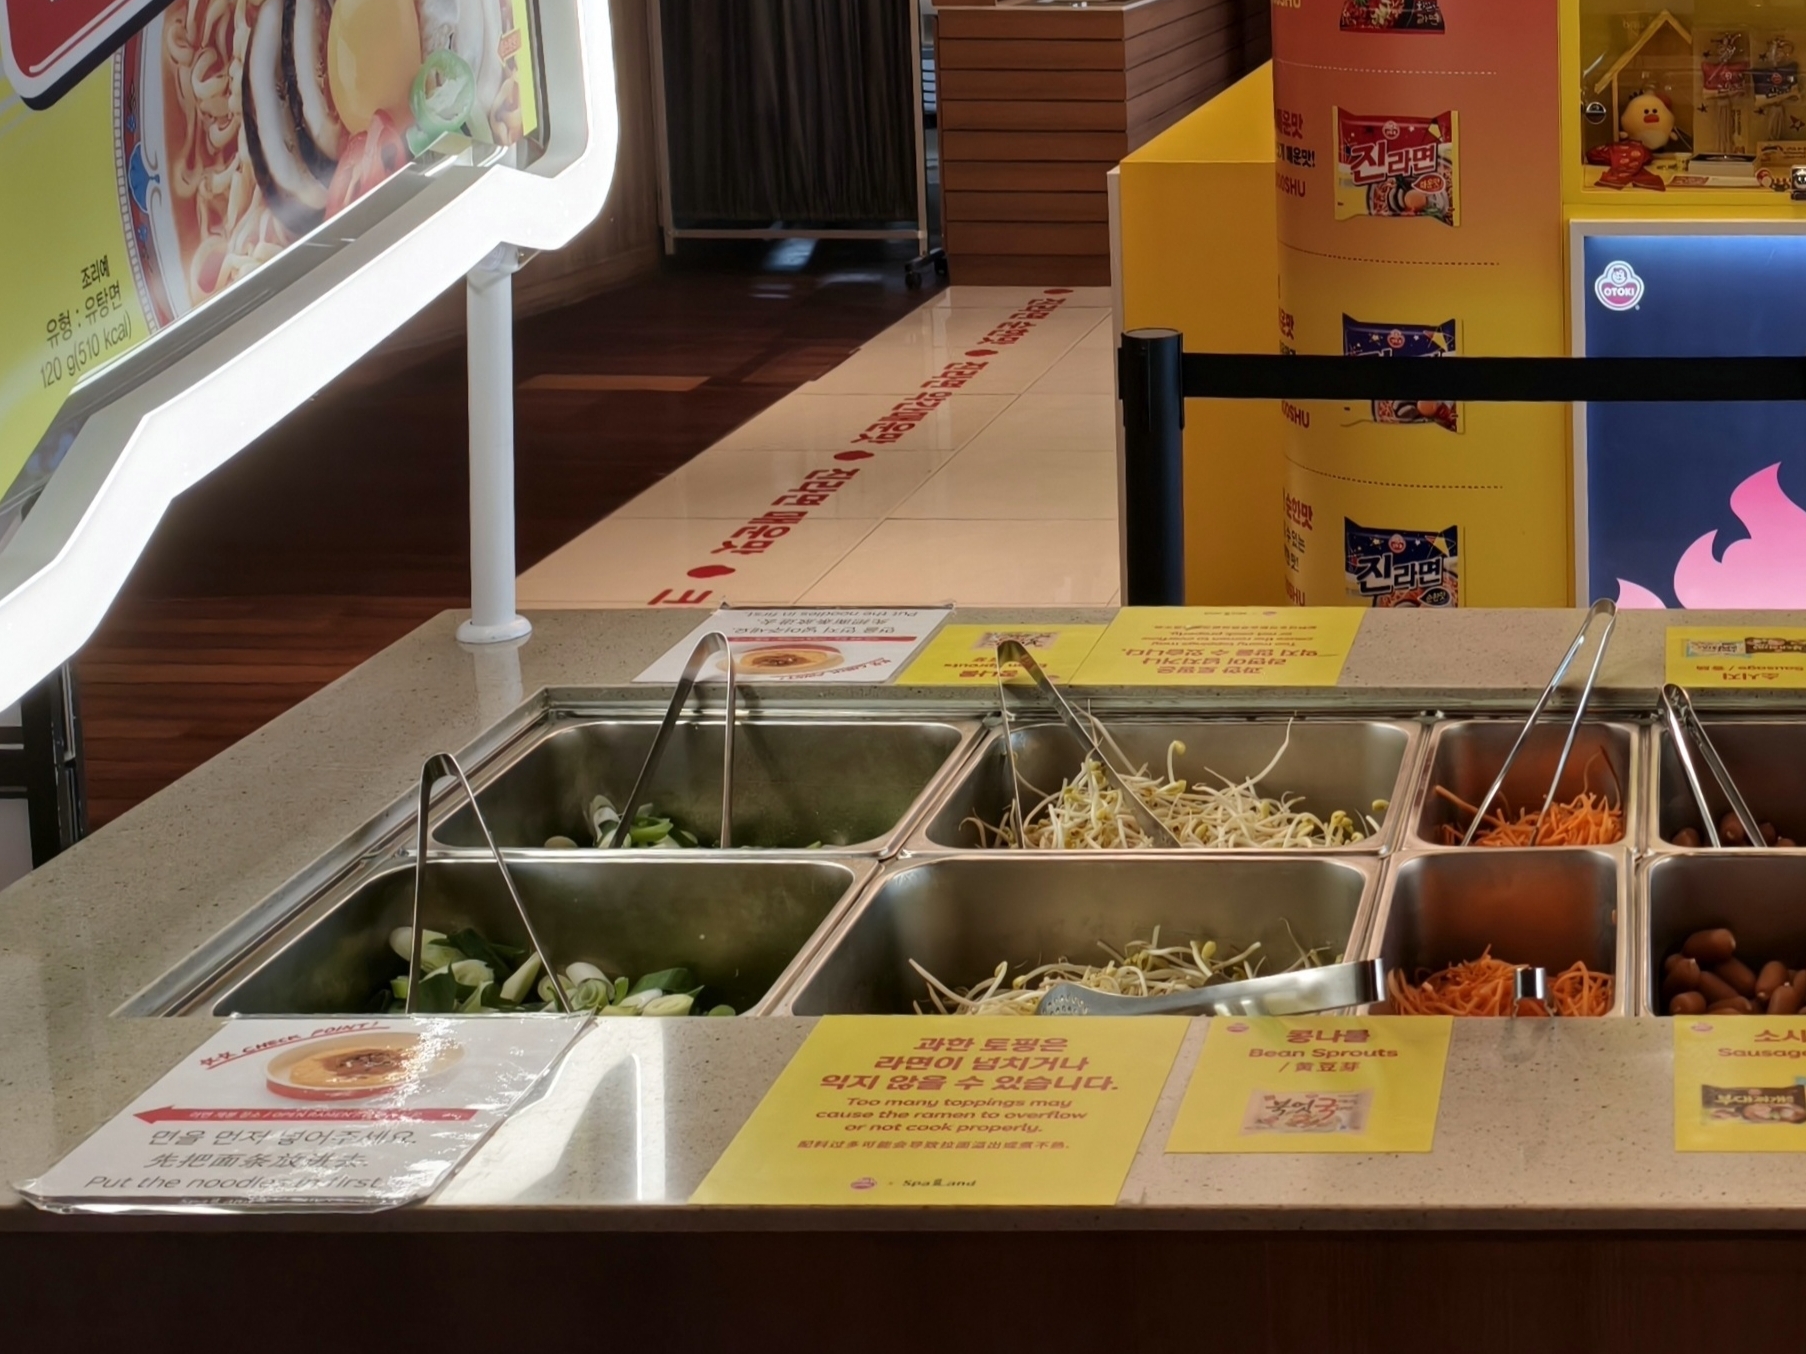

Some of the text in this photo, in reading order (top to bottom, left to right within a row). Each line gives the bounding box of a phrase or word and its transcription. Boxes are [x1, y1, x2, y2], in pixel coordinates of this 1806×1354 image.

[1351, 139, 1439, 186] 진라면
[80, 254, 111, 289] 조리예
[1602, 285, 1636, 297] OTOKI
[46, 280, 123, 349] 유형 유탕면
[40, 310, 133, 389] 120 g(510 kcal)
[921, 361, 989, 389] 진라면
[710, 468, 861, 556] 진라면 매운맛
[1356, 552, 1444, 598] 진라면
[242, 1021, 380, 1055] CHECK POINT!
[913, 1037, 1069, 1053] 과한 토핑은
[1286, 1029, 1371, 1044] 콩나물
[1248, 1048, 1399, 1059] Bean Sprouts
[874, 1056, 1090, 1072] 라면이 넘치거나
[820, 1074, 1119, 1091] 익지 않을 수 있습니다.
[846, 1097, 1073, 1109] Too many toppings may
[815, 1110, 1088, 1120] cause the ramen to overflow
[844, 1122, 1044, 1134] or not cook properly.
[148, 1129, 418, 1146] 면을 먼저 넣어주세요.
[83, 1175, 285, 1190] Put the noodles
